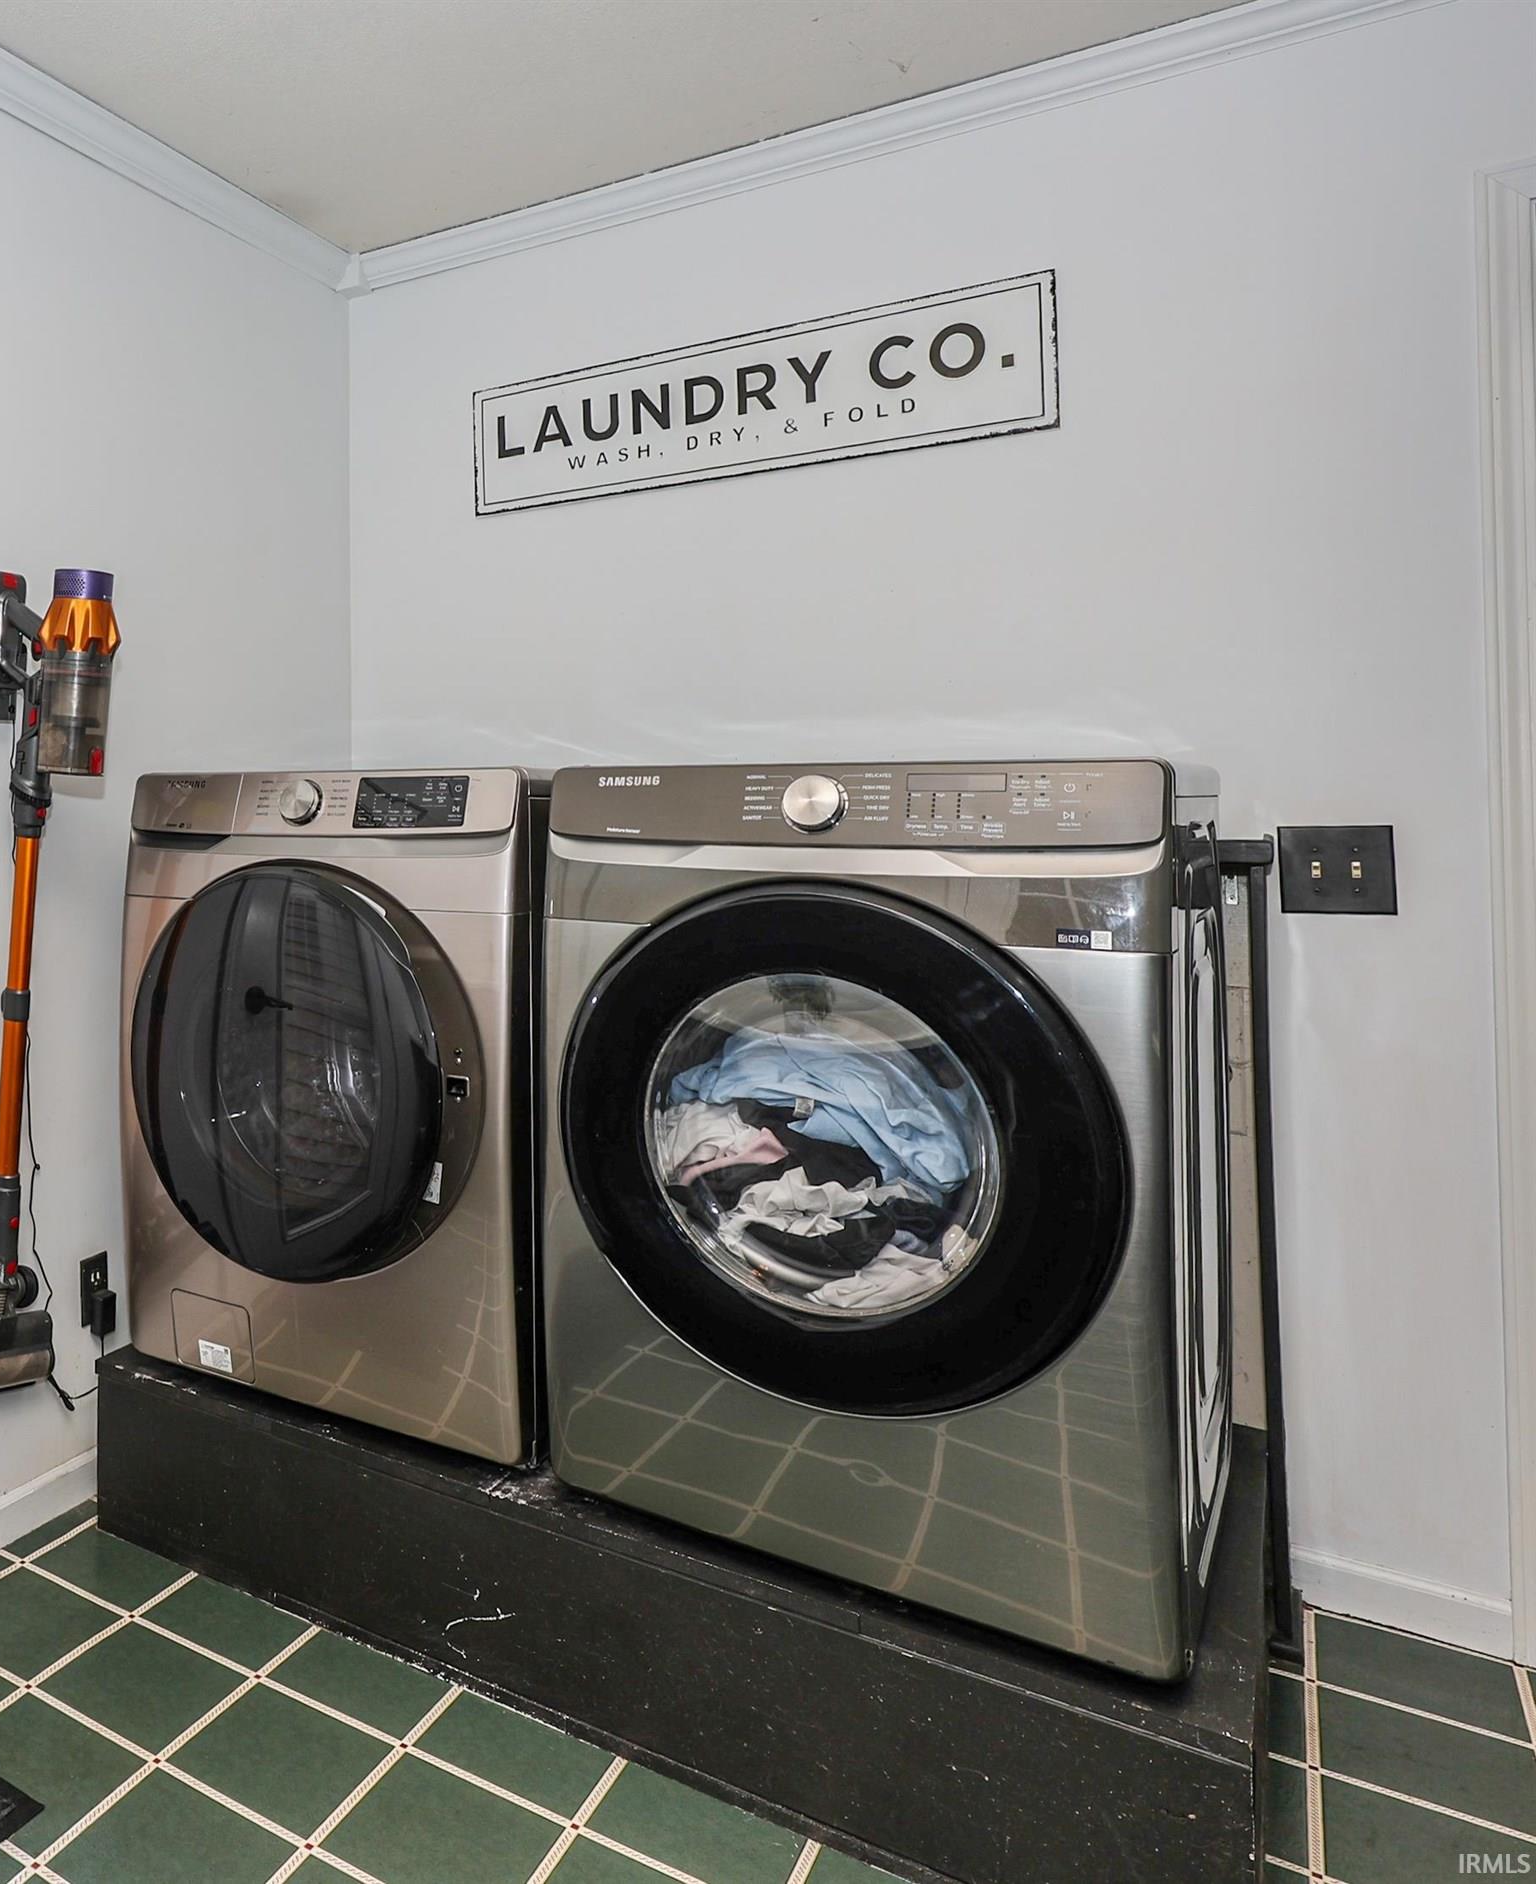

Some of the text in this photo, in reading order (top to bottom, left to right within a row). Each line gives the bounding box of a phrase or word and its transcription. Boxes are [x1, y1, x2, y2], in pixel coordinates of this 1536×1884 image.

[496, 322, 1015, 459] LAUNDRY CO.
[567, 397, 917, 471] WASH, DRY, & FOLD
[598, 775, 661, 787] SAMSUNG
